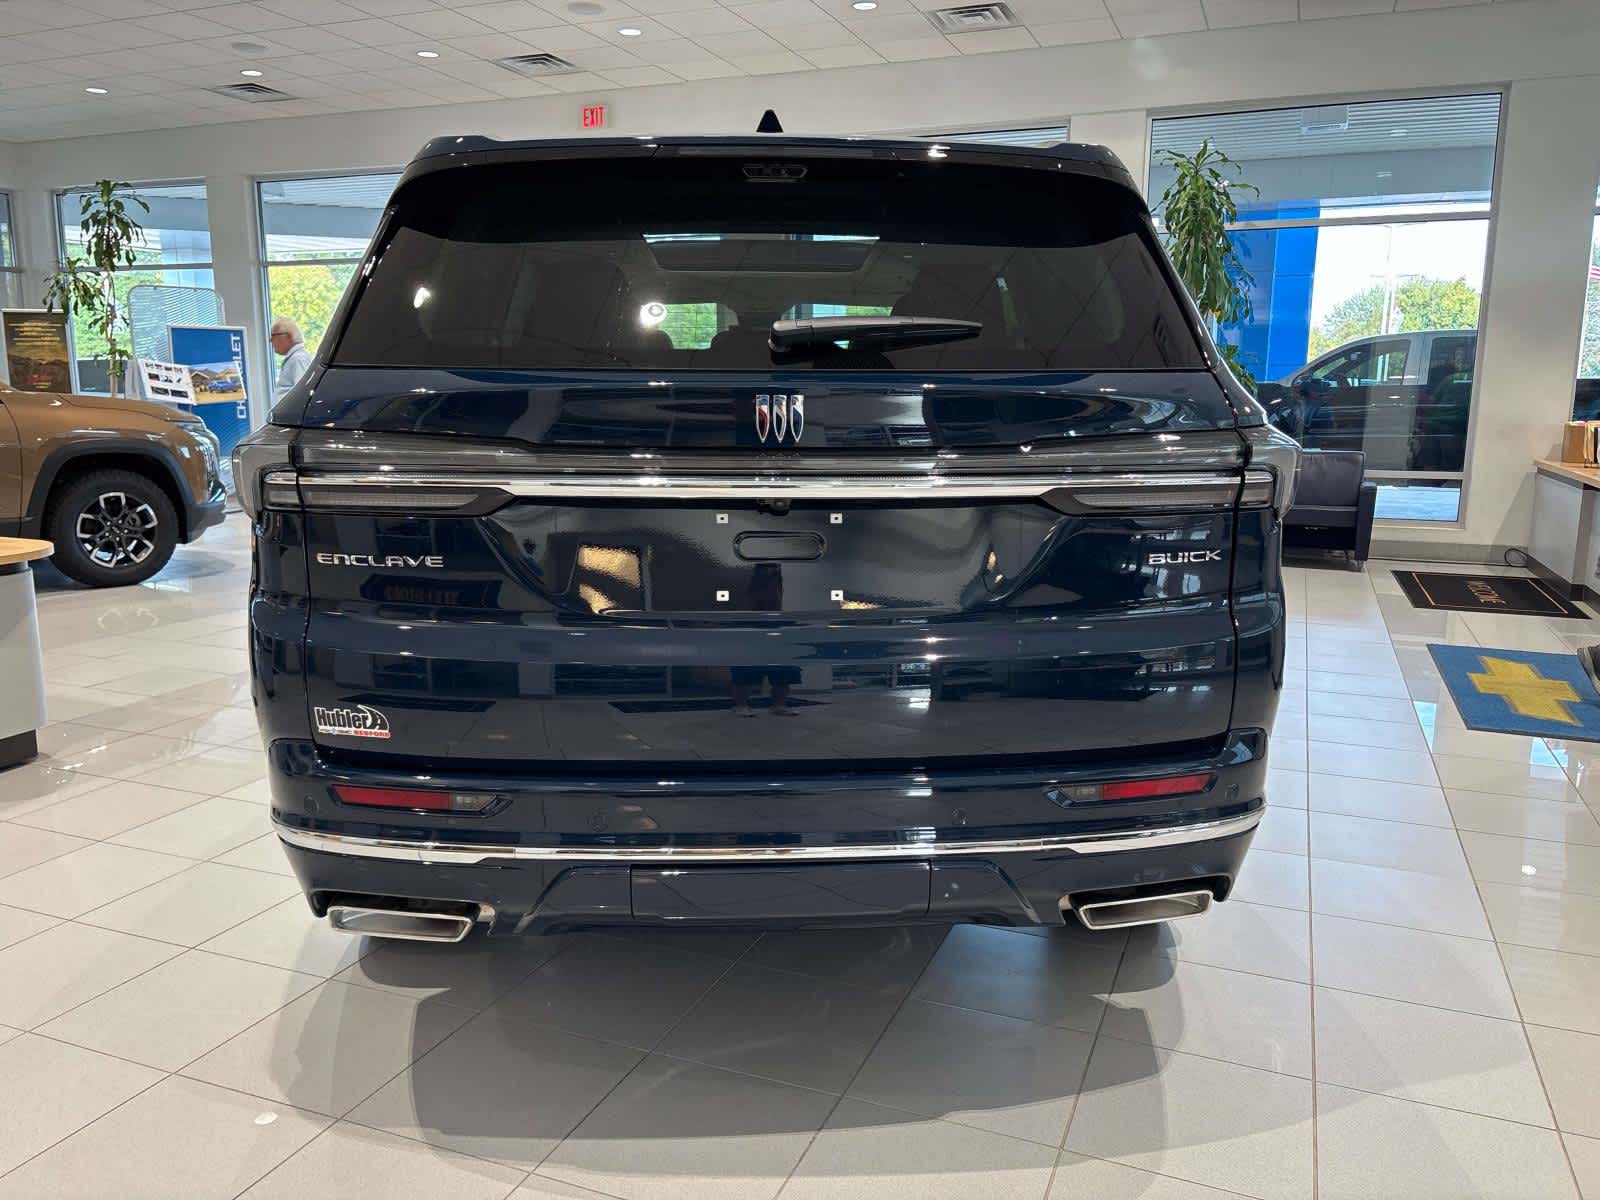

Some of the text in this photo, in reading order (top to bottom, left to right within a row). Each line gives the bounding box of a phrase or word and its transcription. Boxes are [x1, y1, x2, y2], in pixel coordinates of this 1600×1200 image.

[583, 106, 605, 128] EXIT
[316, 552, 444, 567] ENCLAVE
[1148, 550, 1222, 565] BUICK
[314, 707, 370, 729] Hubler
